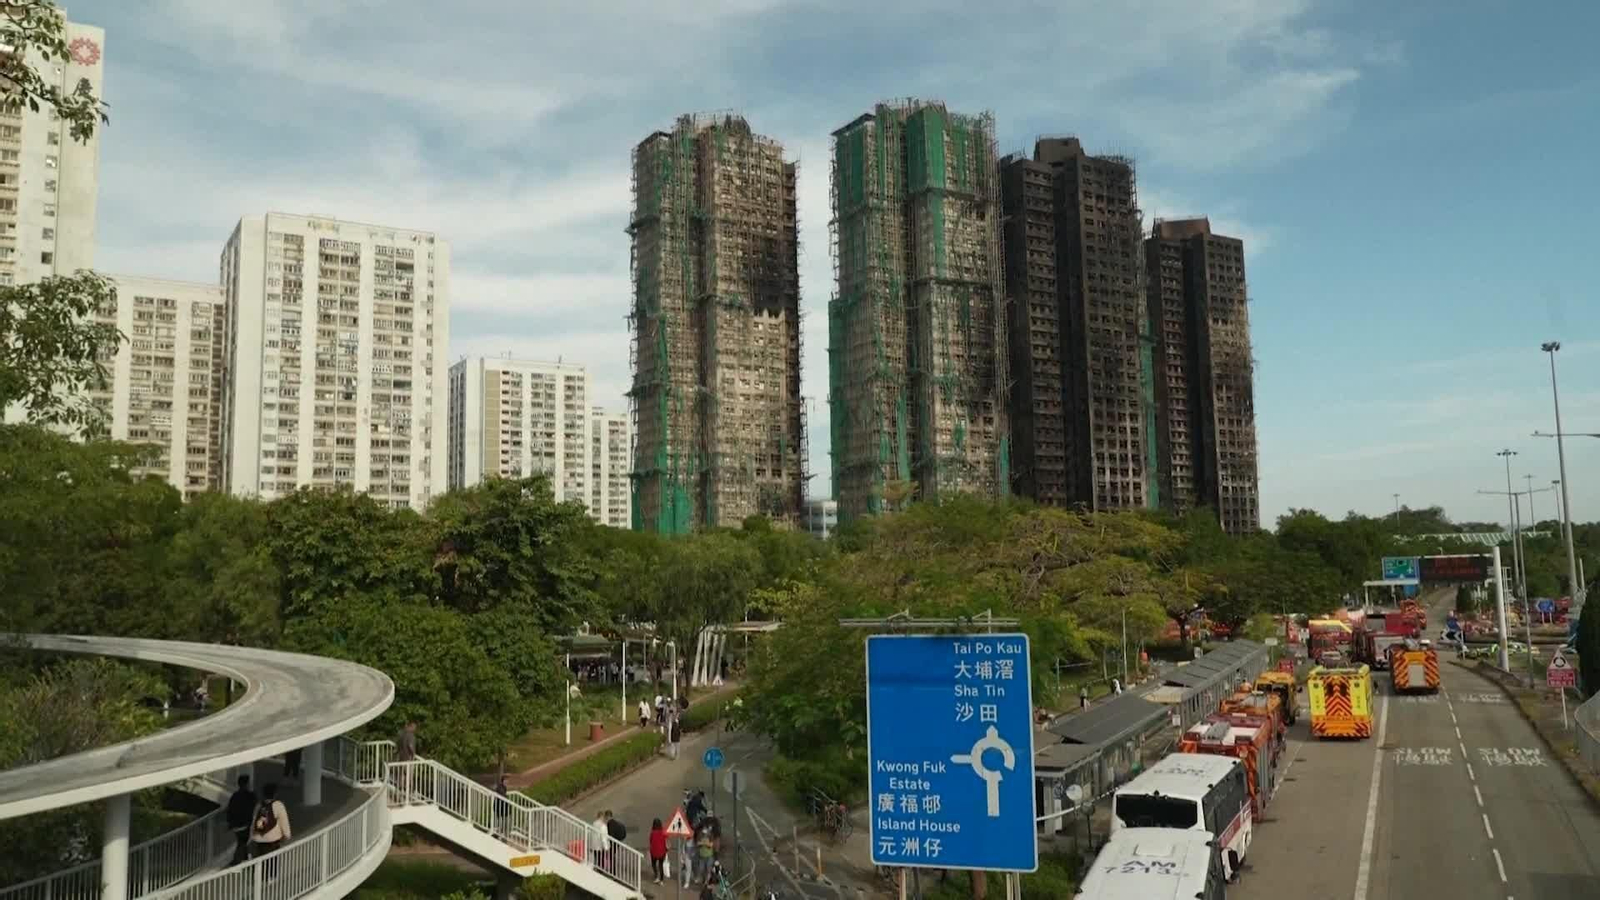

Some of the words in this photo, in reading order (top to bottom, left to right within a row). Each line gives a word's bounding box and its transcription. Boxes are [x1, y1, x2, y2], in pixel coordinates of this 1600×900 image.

[953, 642, 971, 654] Tai
[976, 642, 992, 654] Po
[997, 642, 1022, 654] Kau
[953, 659, 1014, 681] 大埔滘
[954, 684, 979, 697] Sha
[984, 684, 1005, 697] Tin
[955, 702, 998, 723] 沙田
[876, 759, 919, 775] Kwong
[923, 760, 946, 773] Fuk
[889, 777, 931, 791] Estate
[877, 793, 941, 814] 廣福邨
[878, 817, 916, 831] Island
[919, 819, 961, 833] House
[878, 836, 943, 858] 元洲仔
[1123, 860, 1176, 868] AM
